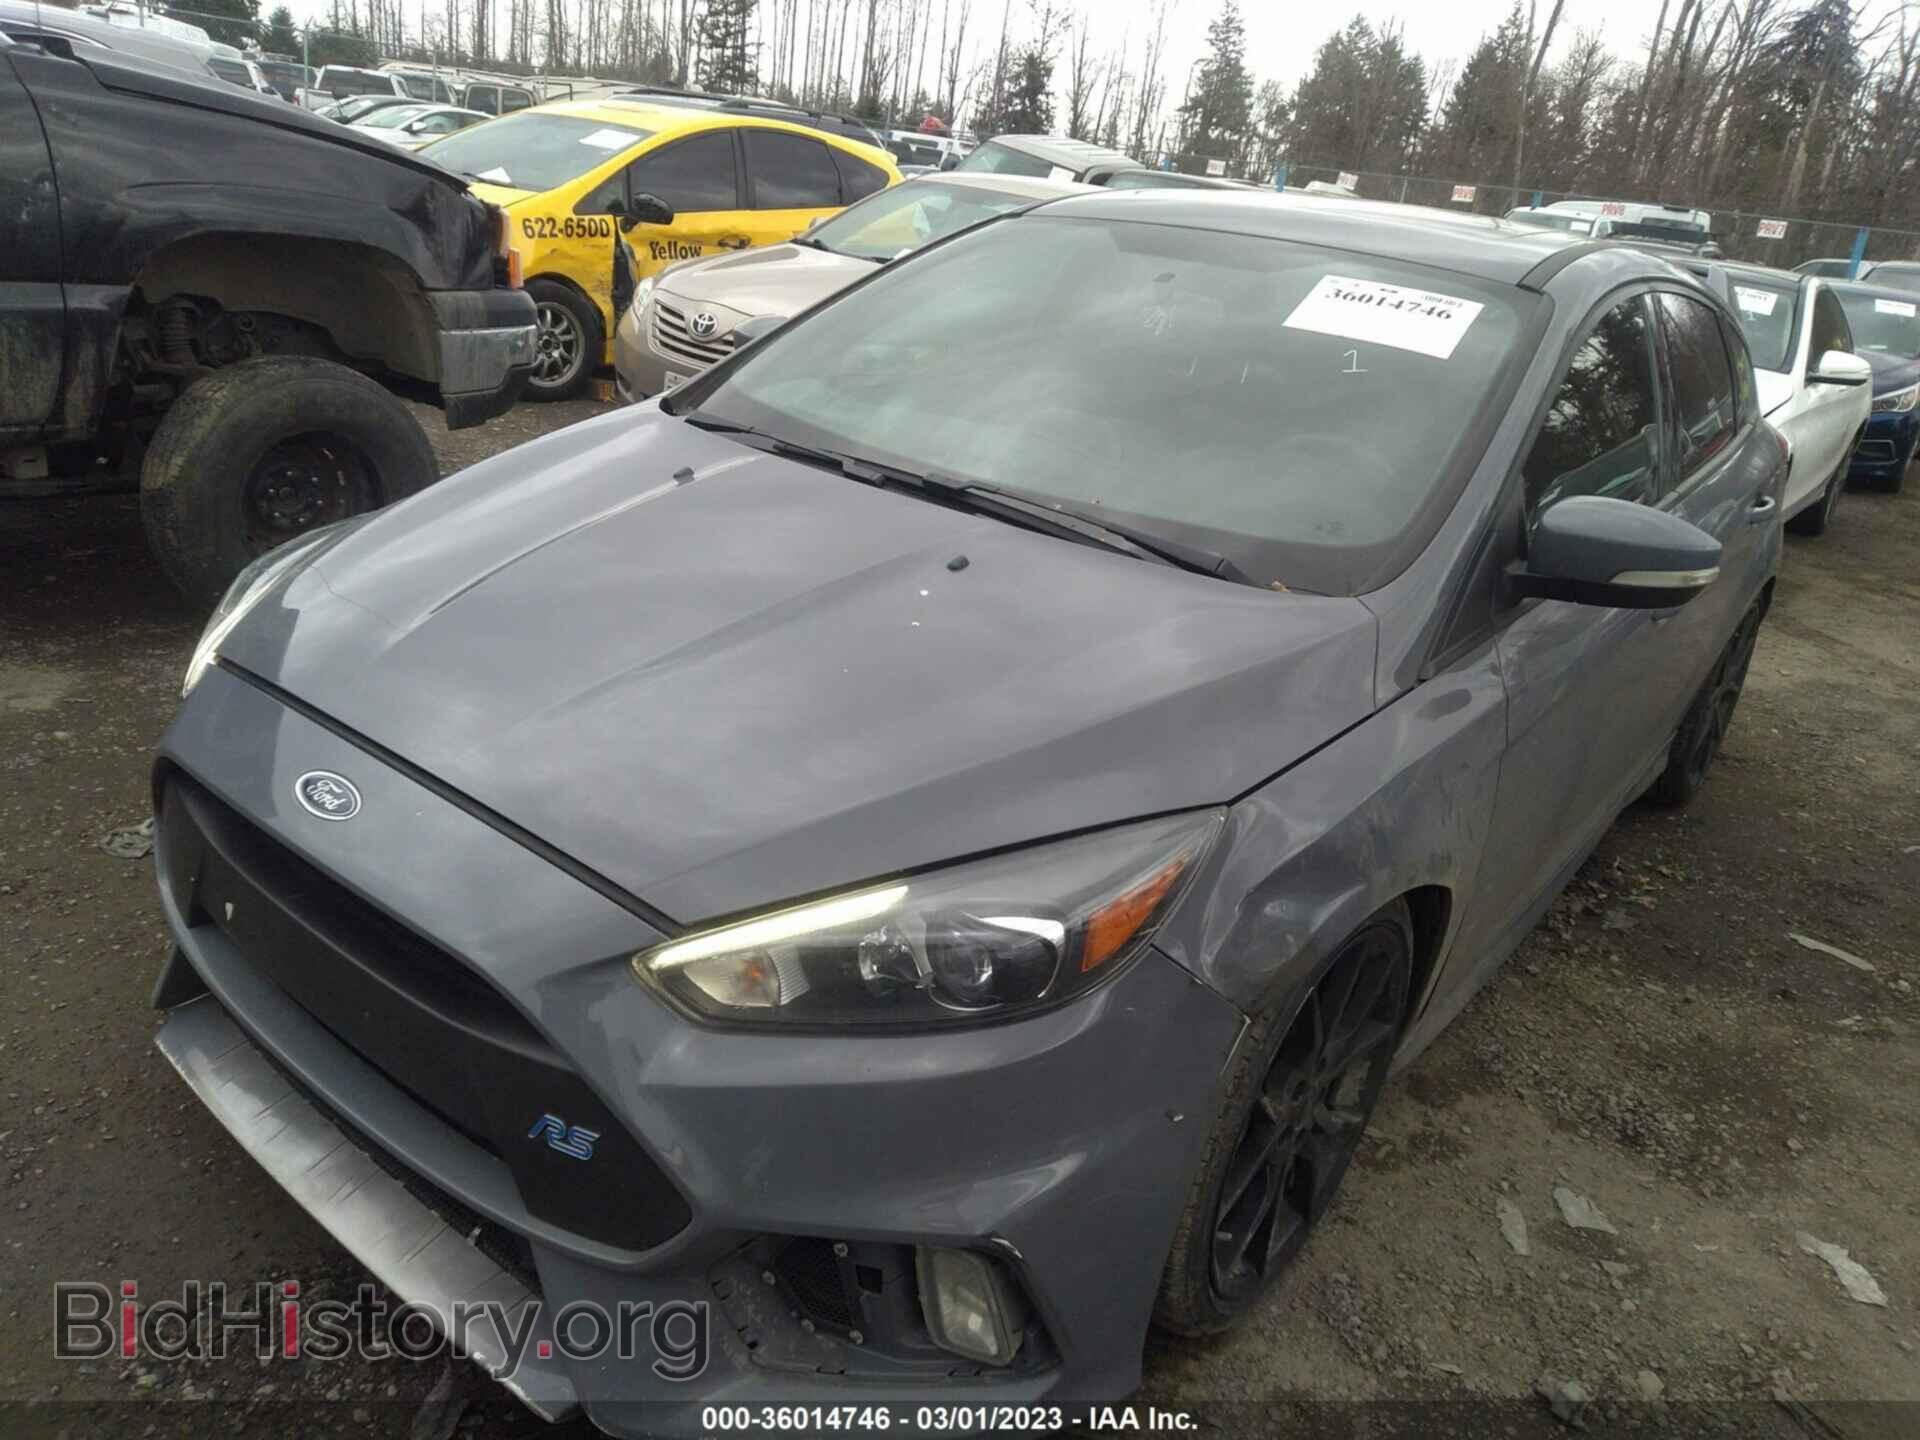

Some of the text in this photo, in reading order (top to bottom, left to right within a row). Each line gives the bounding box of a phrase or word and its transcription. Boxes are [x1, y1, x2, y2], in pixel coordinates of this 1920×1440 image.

[649, 240, 702, 261] Yellow
[1325, 288, 1453, 320] 36014746
[1341, 349, 1369, 373] 1
[306, 780, 347, 810] Ford
[527, 1113, 601, 1161] RS
